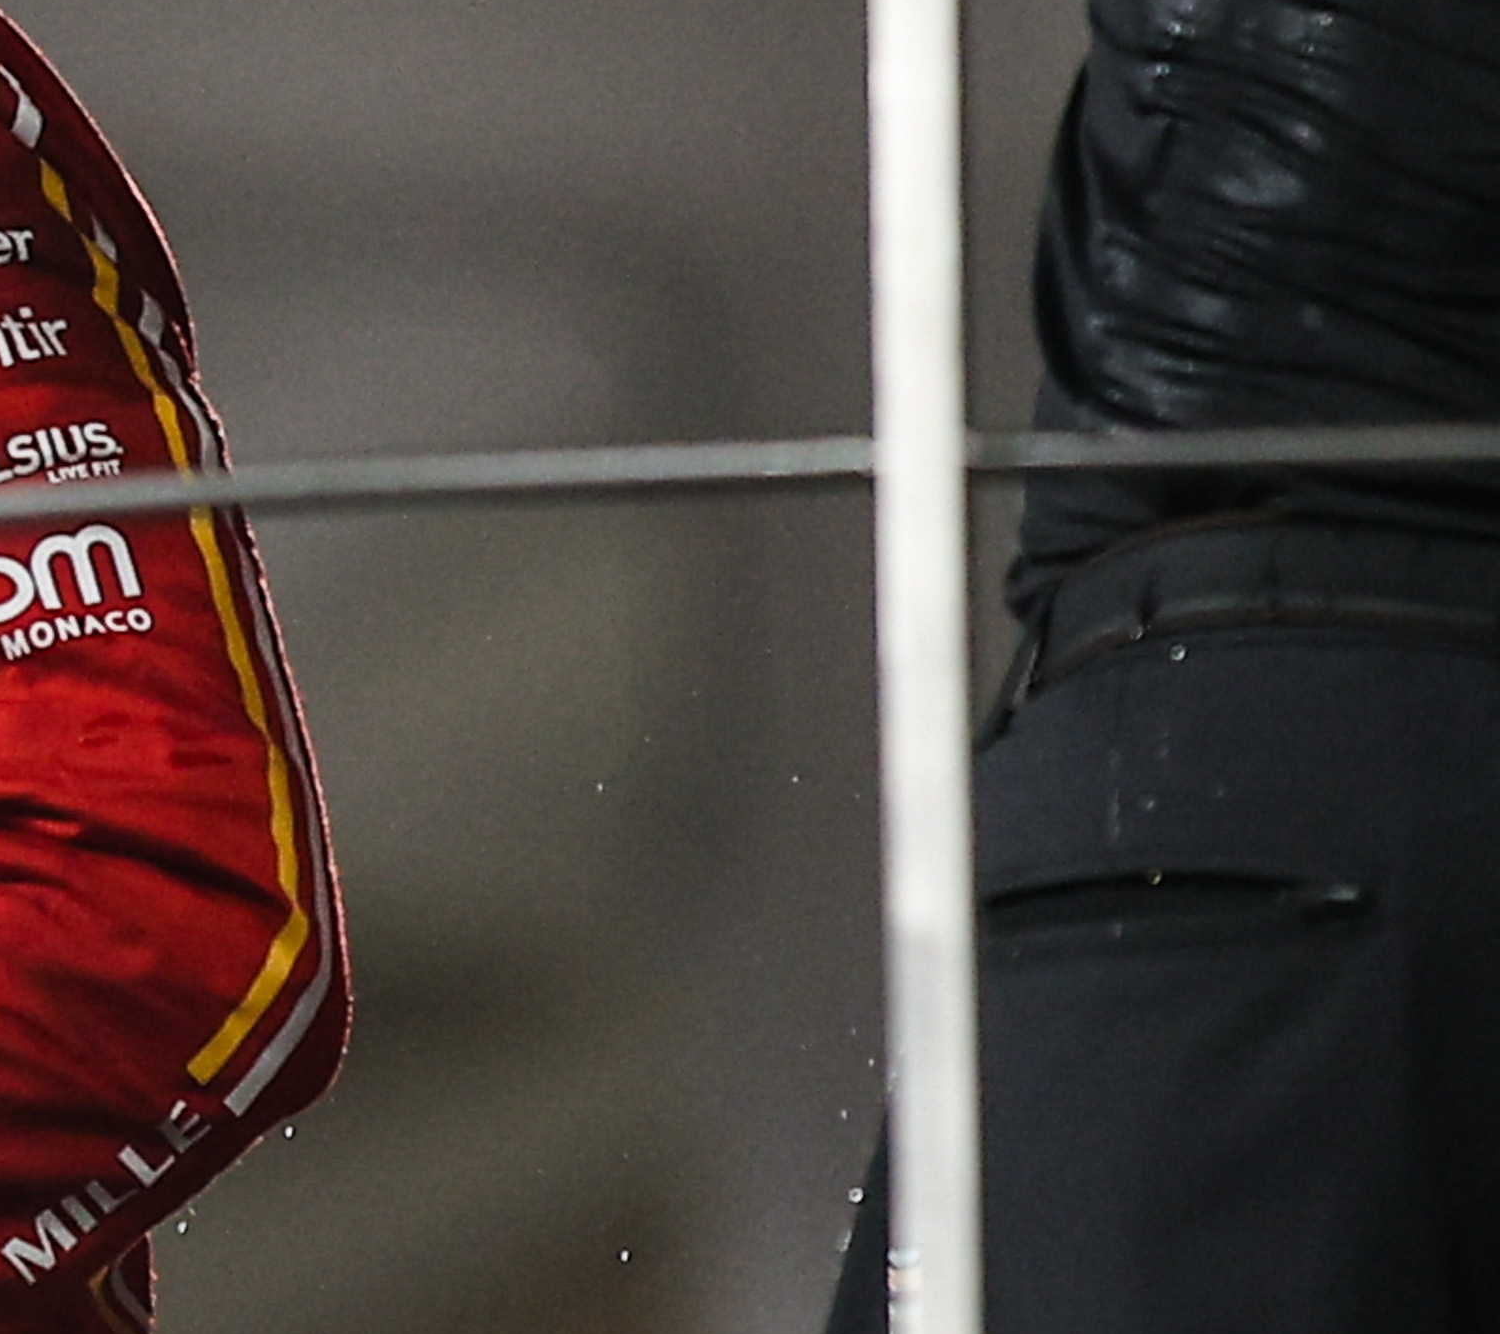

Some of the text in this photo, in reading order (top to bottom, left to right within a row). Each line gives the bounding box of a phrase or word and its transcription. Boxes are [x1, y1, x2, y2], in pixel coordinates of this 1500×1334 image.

[46, 459, 120, 484] LIVE FIT
[0, 608, 152, 660] MONACO
[2, 1100, 210, 1285] MILLE
